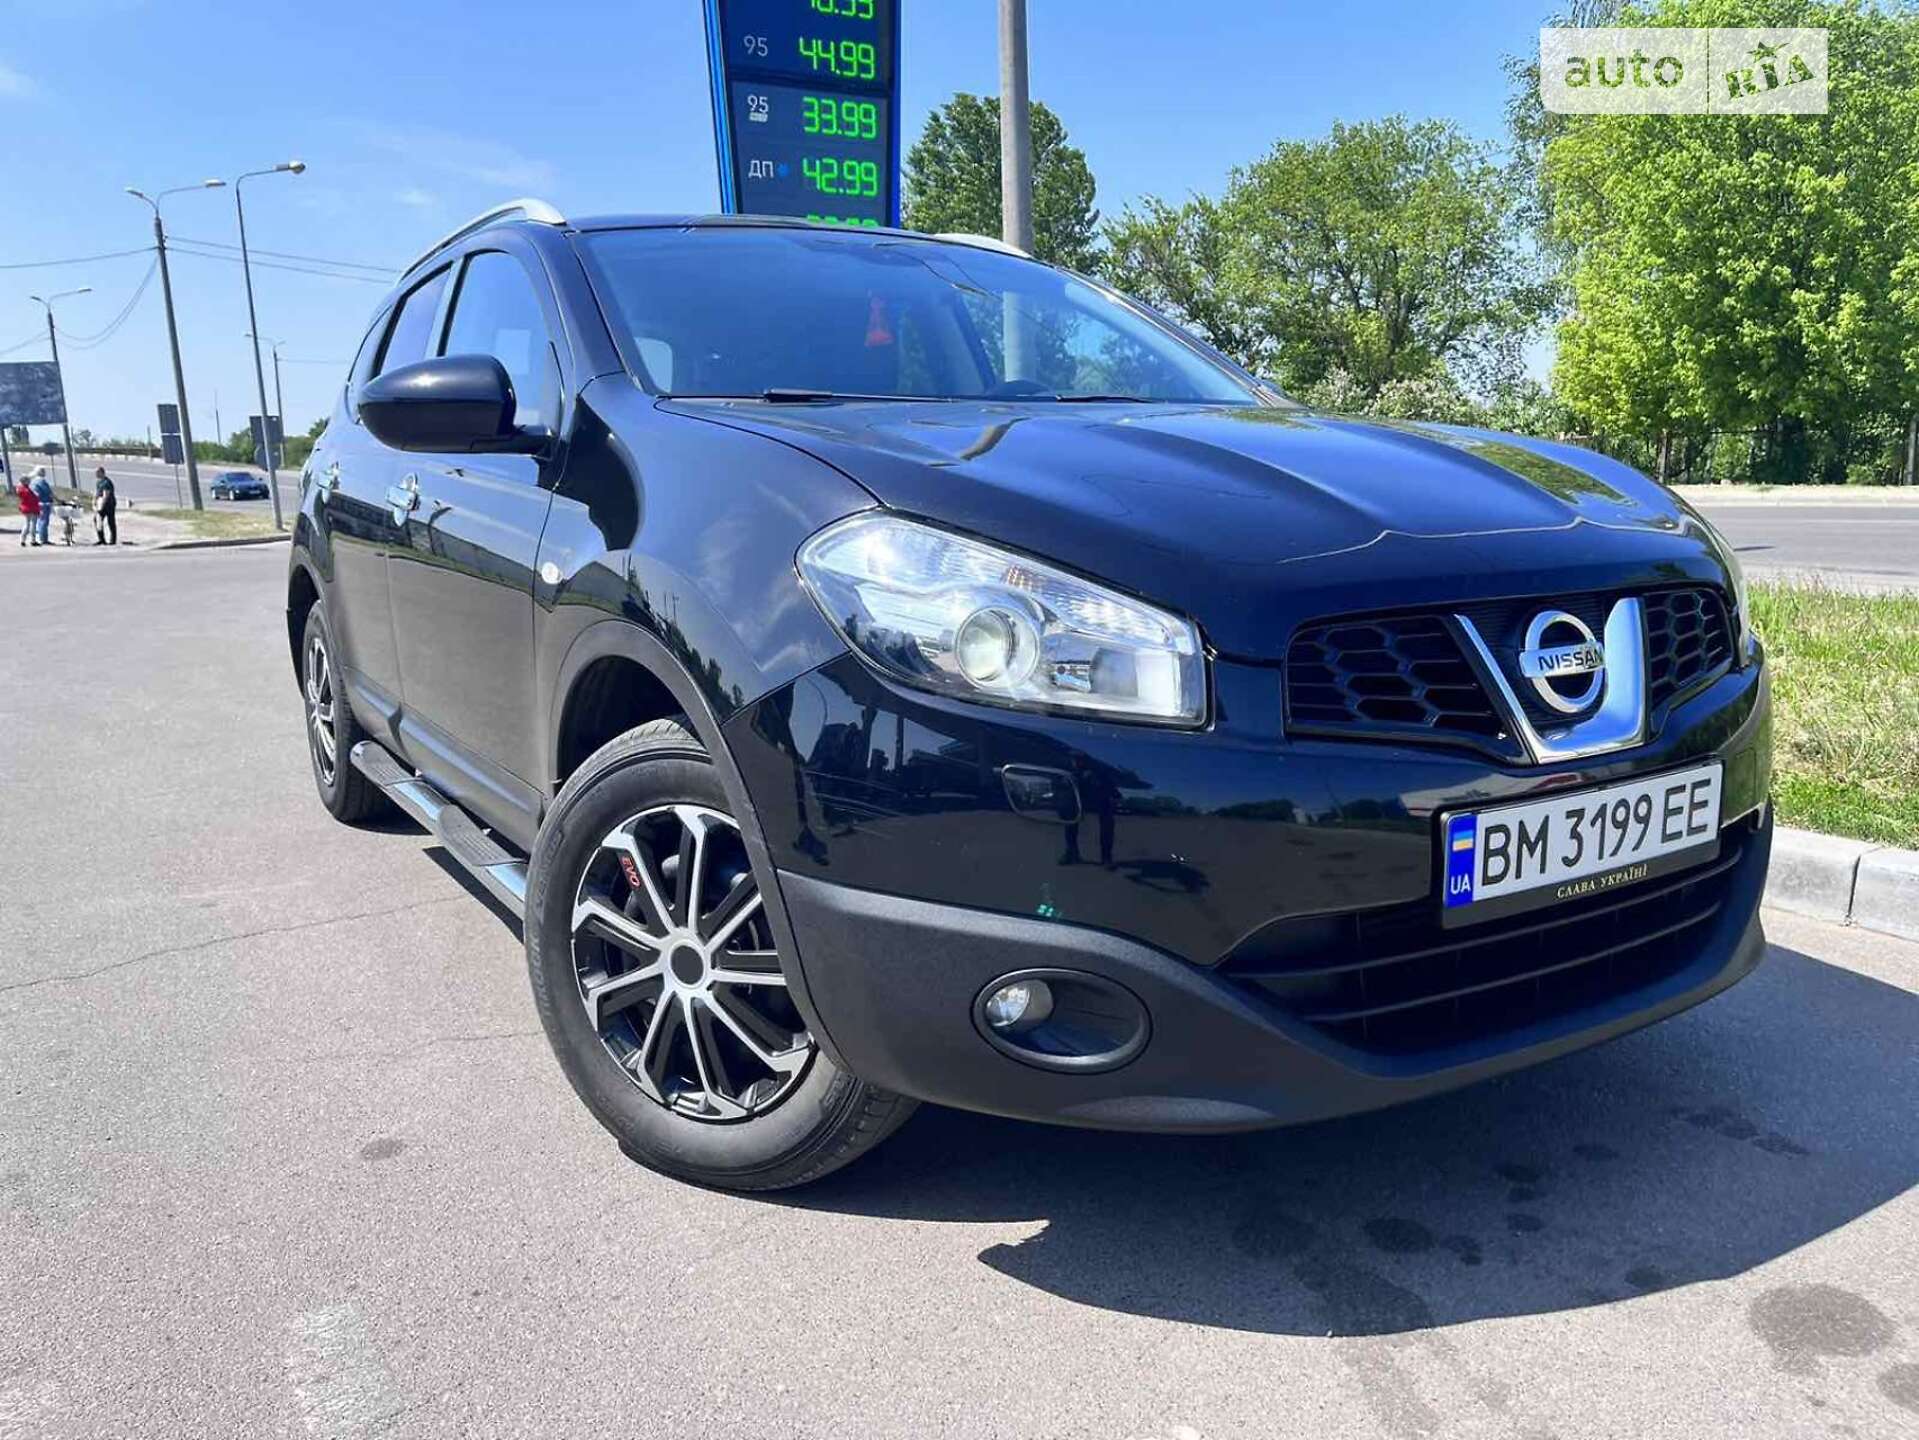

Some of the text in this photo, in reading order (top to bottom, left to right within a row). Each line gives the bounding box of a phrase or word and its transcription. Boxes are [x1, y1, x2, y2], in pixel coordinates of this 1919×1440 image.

[743, 35, 875, 80] 95 44.99
[747, 94, 877, 140] 95 33.99
[748, 158, 878, 196] ДП 42.99
[1537, 645, 1605, 671] NISSAN
[1481, 778, 1712, 887] BM 3199 EE
[622, 855, 641, 888] EVO
[1450, 873, 1472, 896] UA
[1557, 863, 1648, 899] СЛАВА УКРАЇНІ
